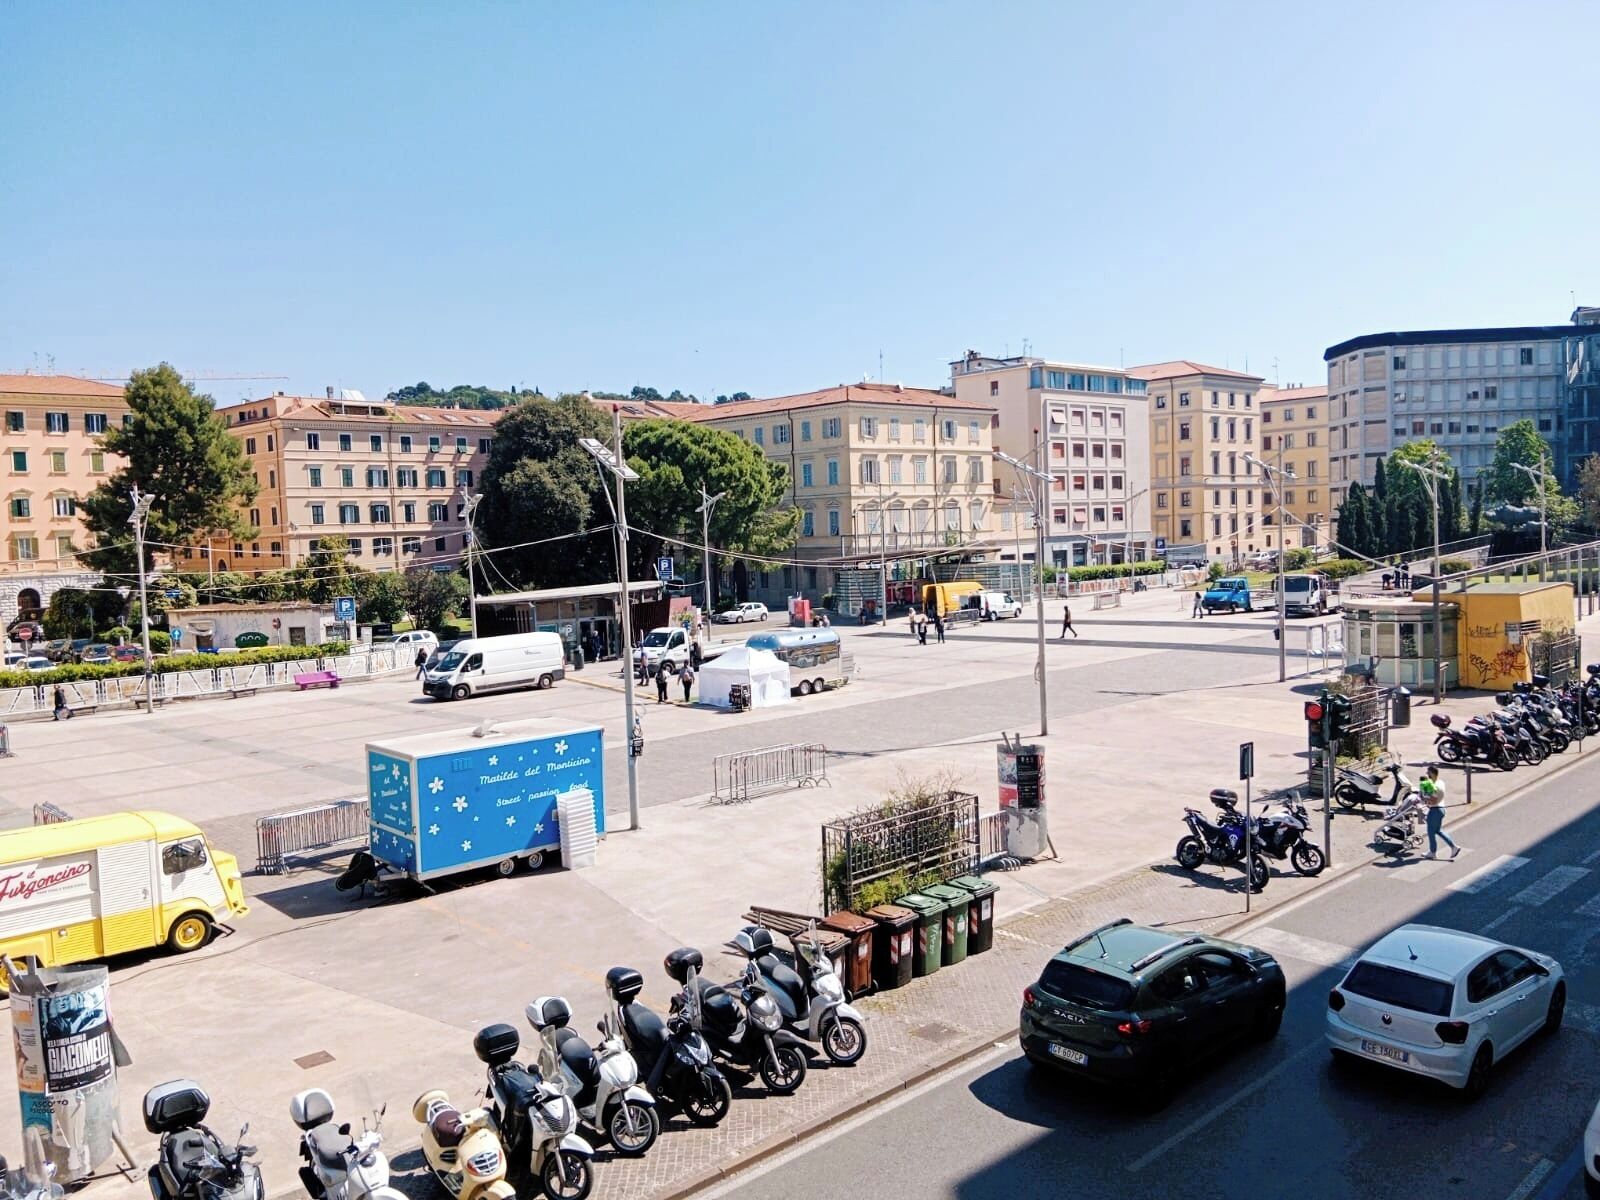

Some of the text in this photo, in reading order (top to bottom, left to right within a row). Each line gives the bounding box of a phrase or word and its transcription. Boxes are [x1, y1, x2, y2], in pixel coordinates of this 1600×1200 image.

[479, 757, 591, 784] Matilde del Monticino
[496, 780, 589, 807] Street passion food
[0, 863, 93, 902] Furgoncino
[27, 869, 36, 879] il
[1053, 1008, 1086, 1025] DACIA
